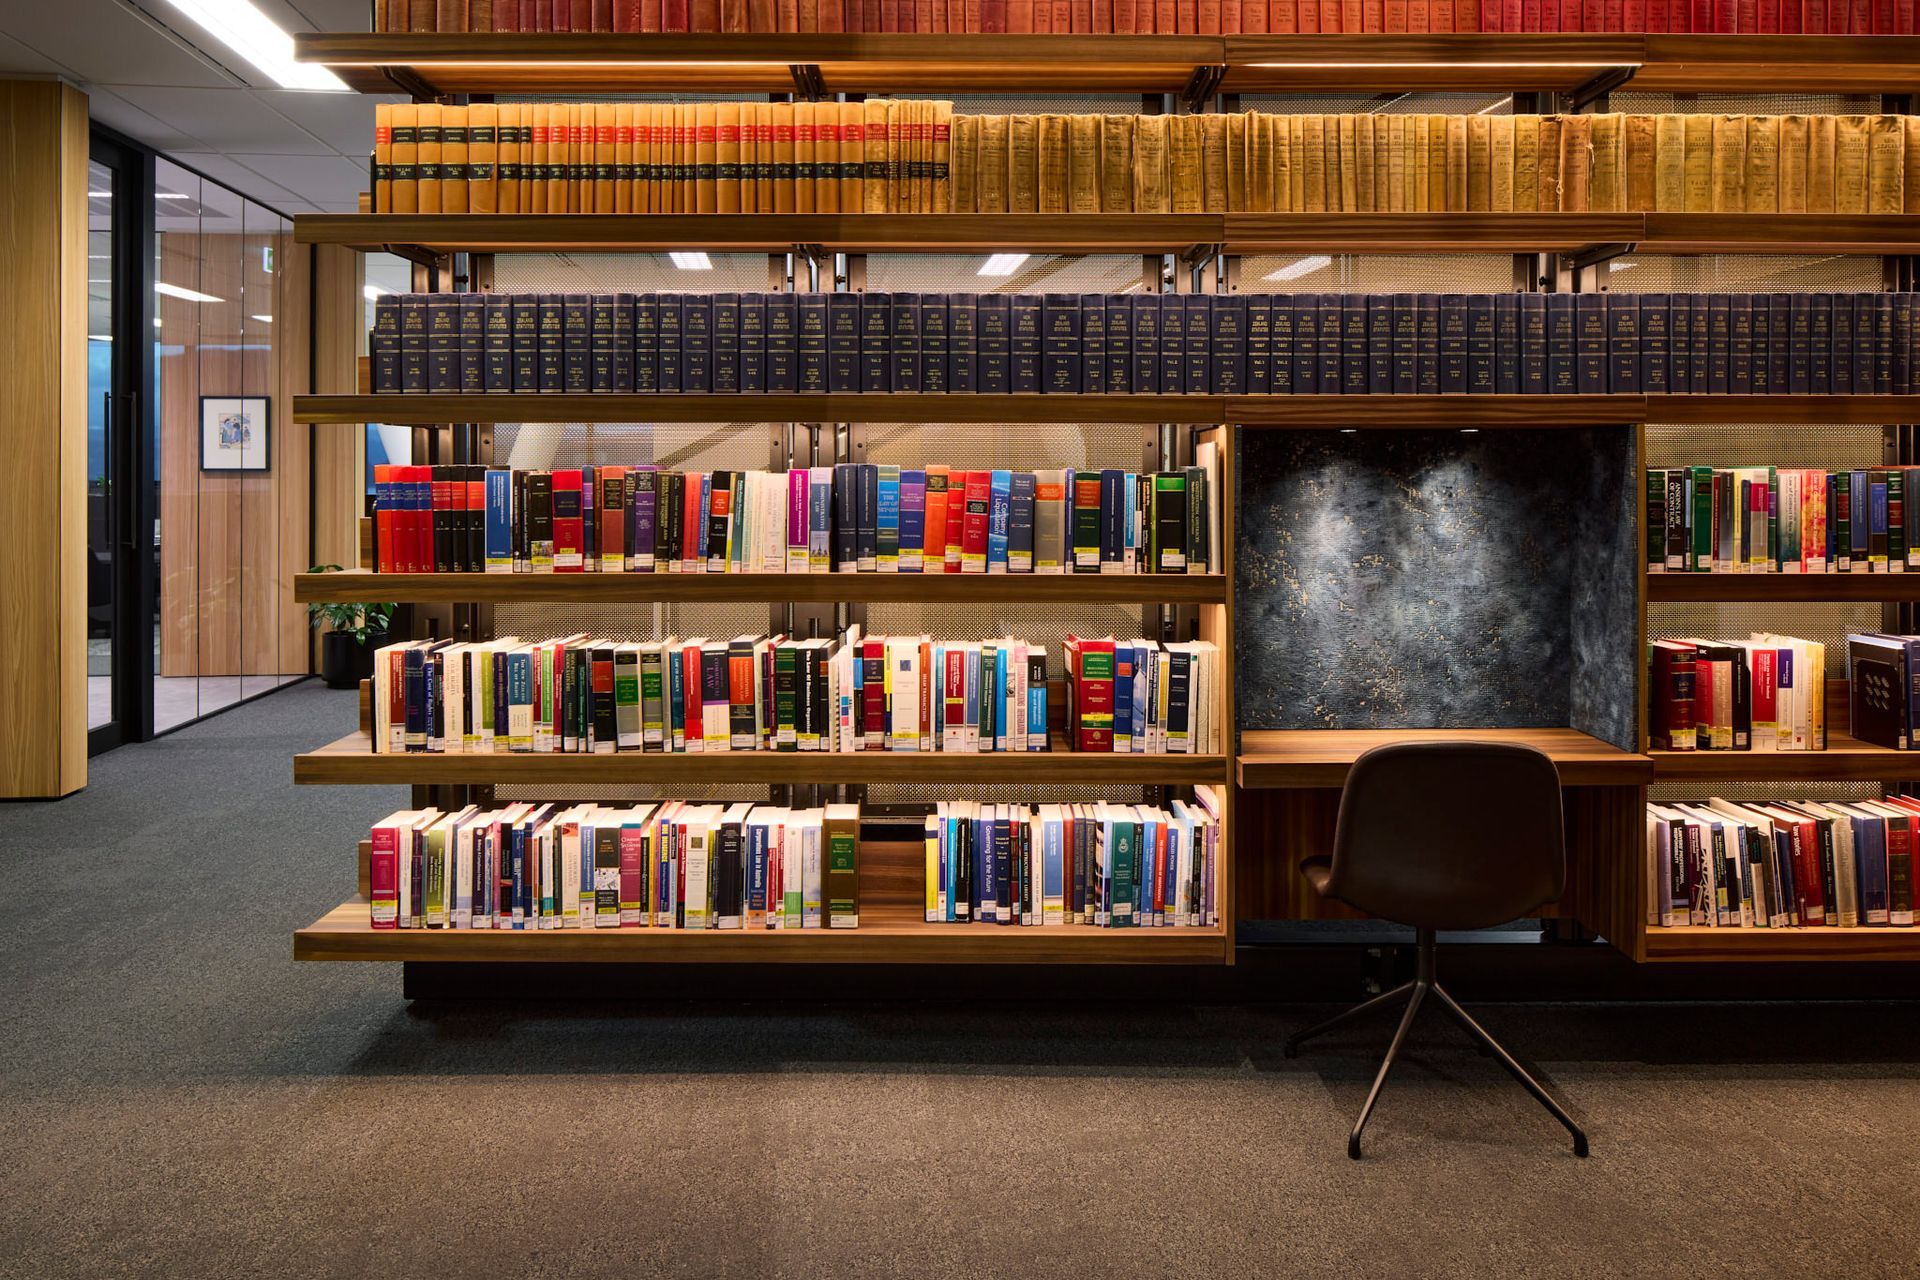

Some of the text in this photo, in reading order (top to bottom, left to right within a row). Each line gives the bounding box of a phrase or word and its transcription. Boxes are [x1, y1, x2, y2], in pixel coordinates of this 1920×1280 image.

[1669, 482, 1675, 490] OF
[993, 498, 1002, 534] Liquidation
[706, 667, 714, 689] LAW
[984, 825, 992, 854] Governing
